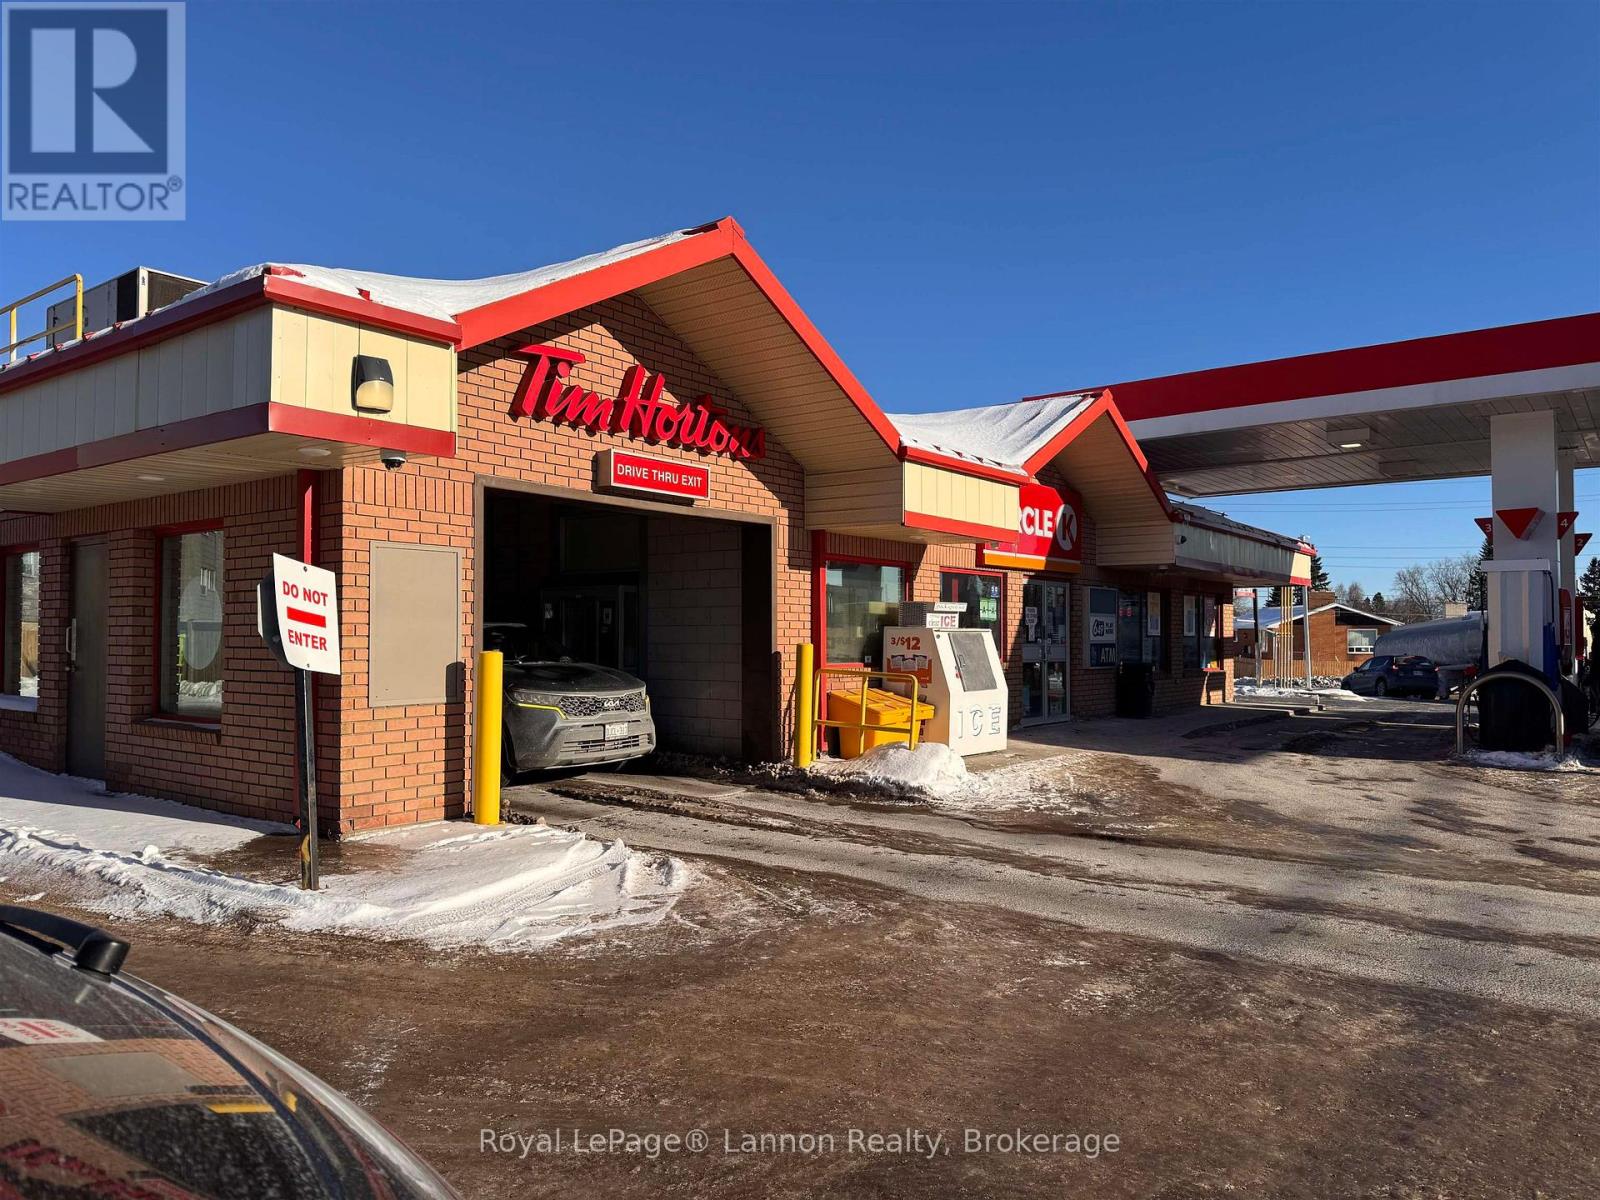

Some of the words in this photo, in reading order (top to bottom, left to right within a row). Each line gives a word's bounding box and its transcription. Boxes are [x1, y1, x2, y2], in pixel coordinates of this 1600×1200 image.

[511, 343, 612, 432] Tim
[617, 463, 649, 479] DRIVE
[652, 469, 679, 484] THRU
[681, 475, 702, 488] EXIT
[1484, 523, 1492, 533] 3
[1560, 518, 1569, 528] 4
[282, 581, 299, 599] DO
[303, 587, 328, 607] NOT
[940, 615, 956, 627] ICE
[287, 629, 328, 651] ENTER
[1100, 647, 1116, 664] ATM
[954, 704, 1001, 739] ICE
